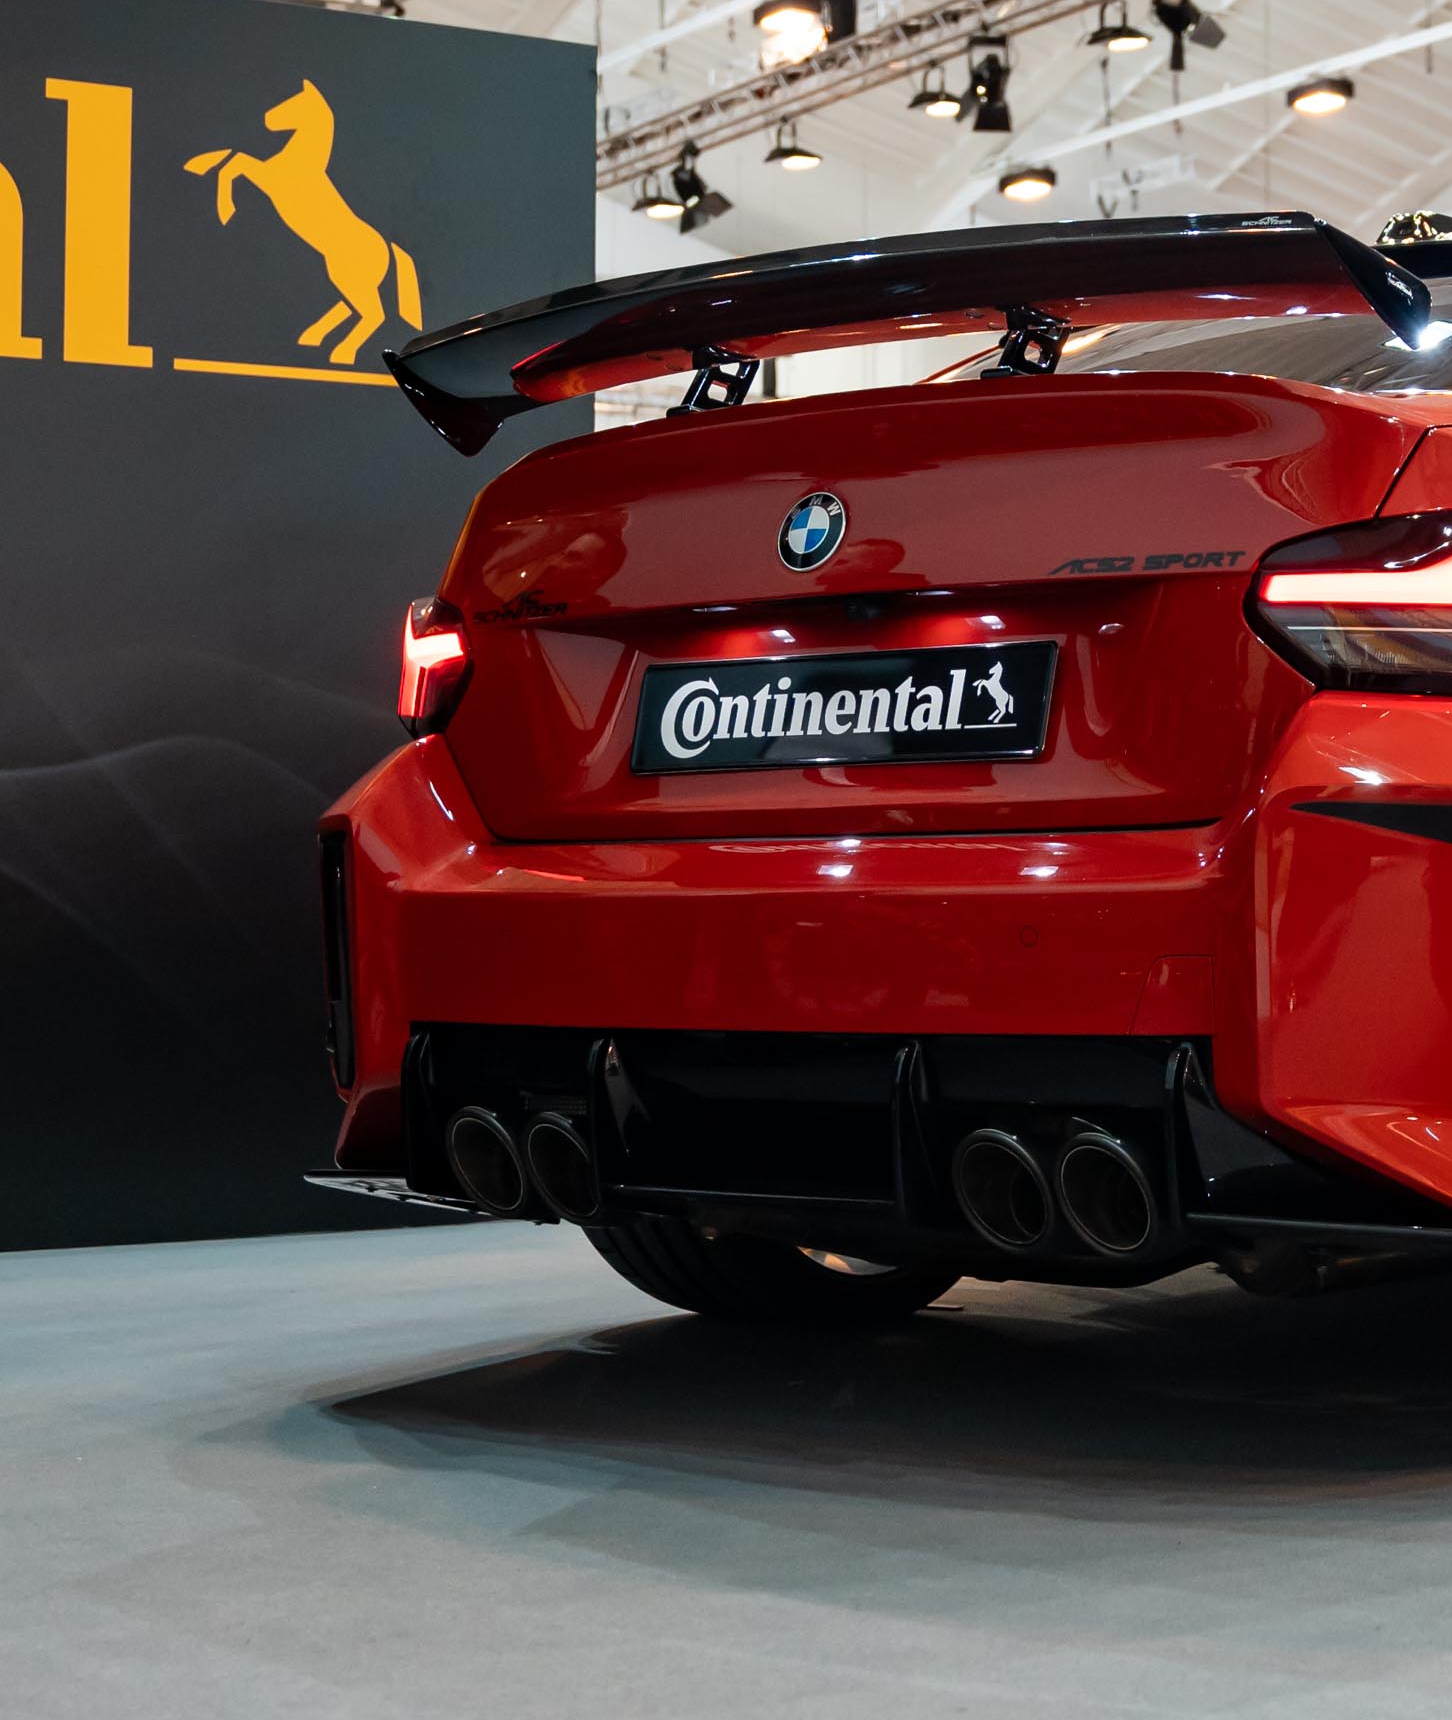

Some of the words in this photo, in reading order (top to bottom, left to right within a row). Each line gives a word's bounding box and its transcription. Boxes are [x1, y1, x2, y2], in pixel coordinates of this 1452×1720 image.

[790, 495, 841, 519] BMW
[1048, 556, 1135, 576] ACS2
[1142, 550, 1246, 572] SPORT
[660, 668, 967, 759] Continental
